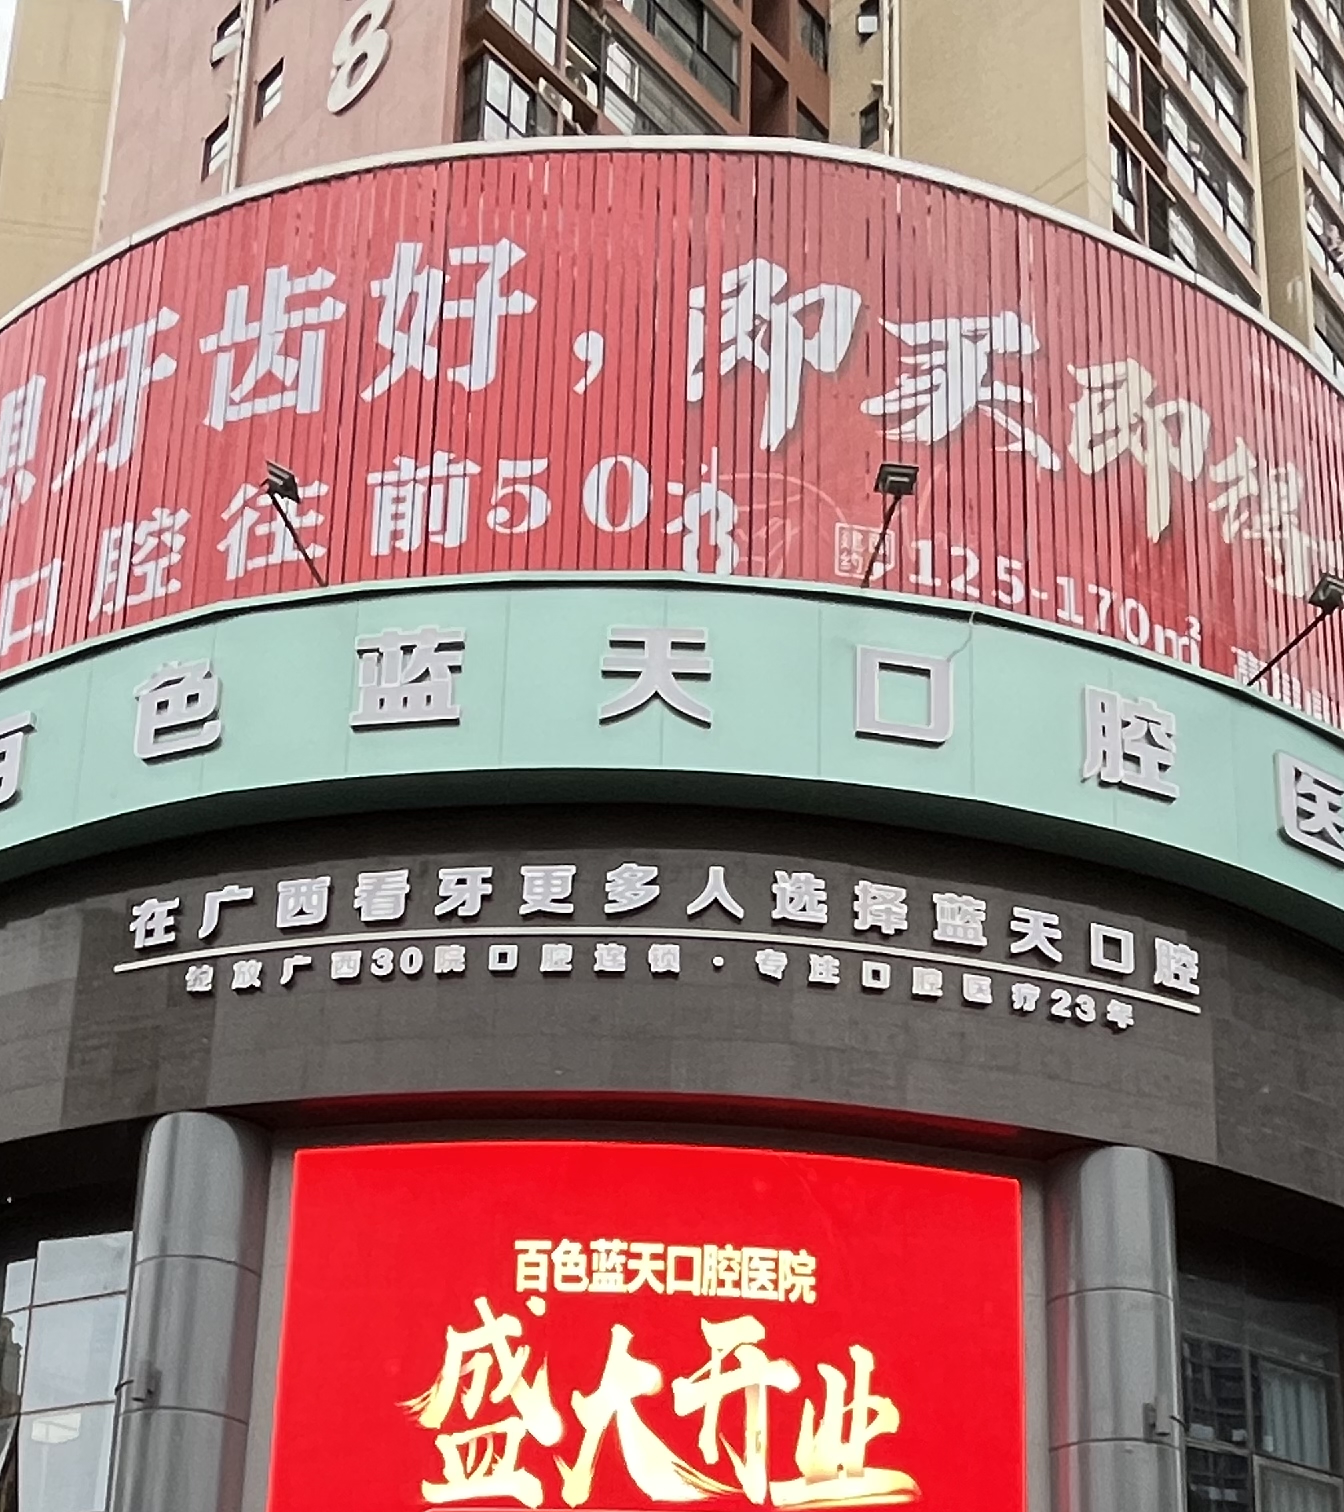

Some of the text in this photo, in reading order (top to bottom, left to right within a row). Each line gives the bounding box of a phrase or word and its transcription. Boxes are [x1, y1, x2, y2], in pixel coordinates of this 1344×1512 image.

[128, 862, 1202, 997] 在广西看牙更多人选择蓝天口腔
[513, 1238, 817, 1304] 百色蓝天口腔医院
[396, 1297, 923, 1510] 盛大开业
